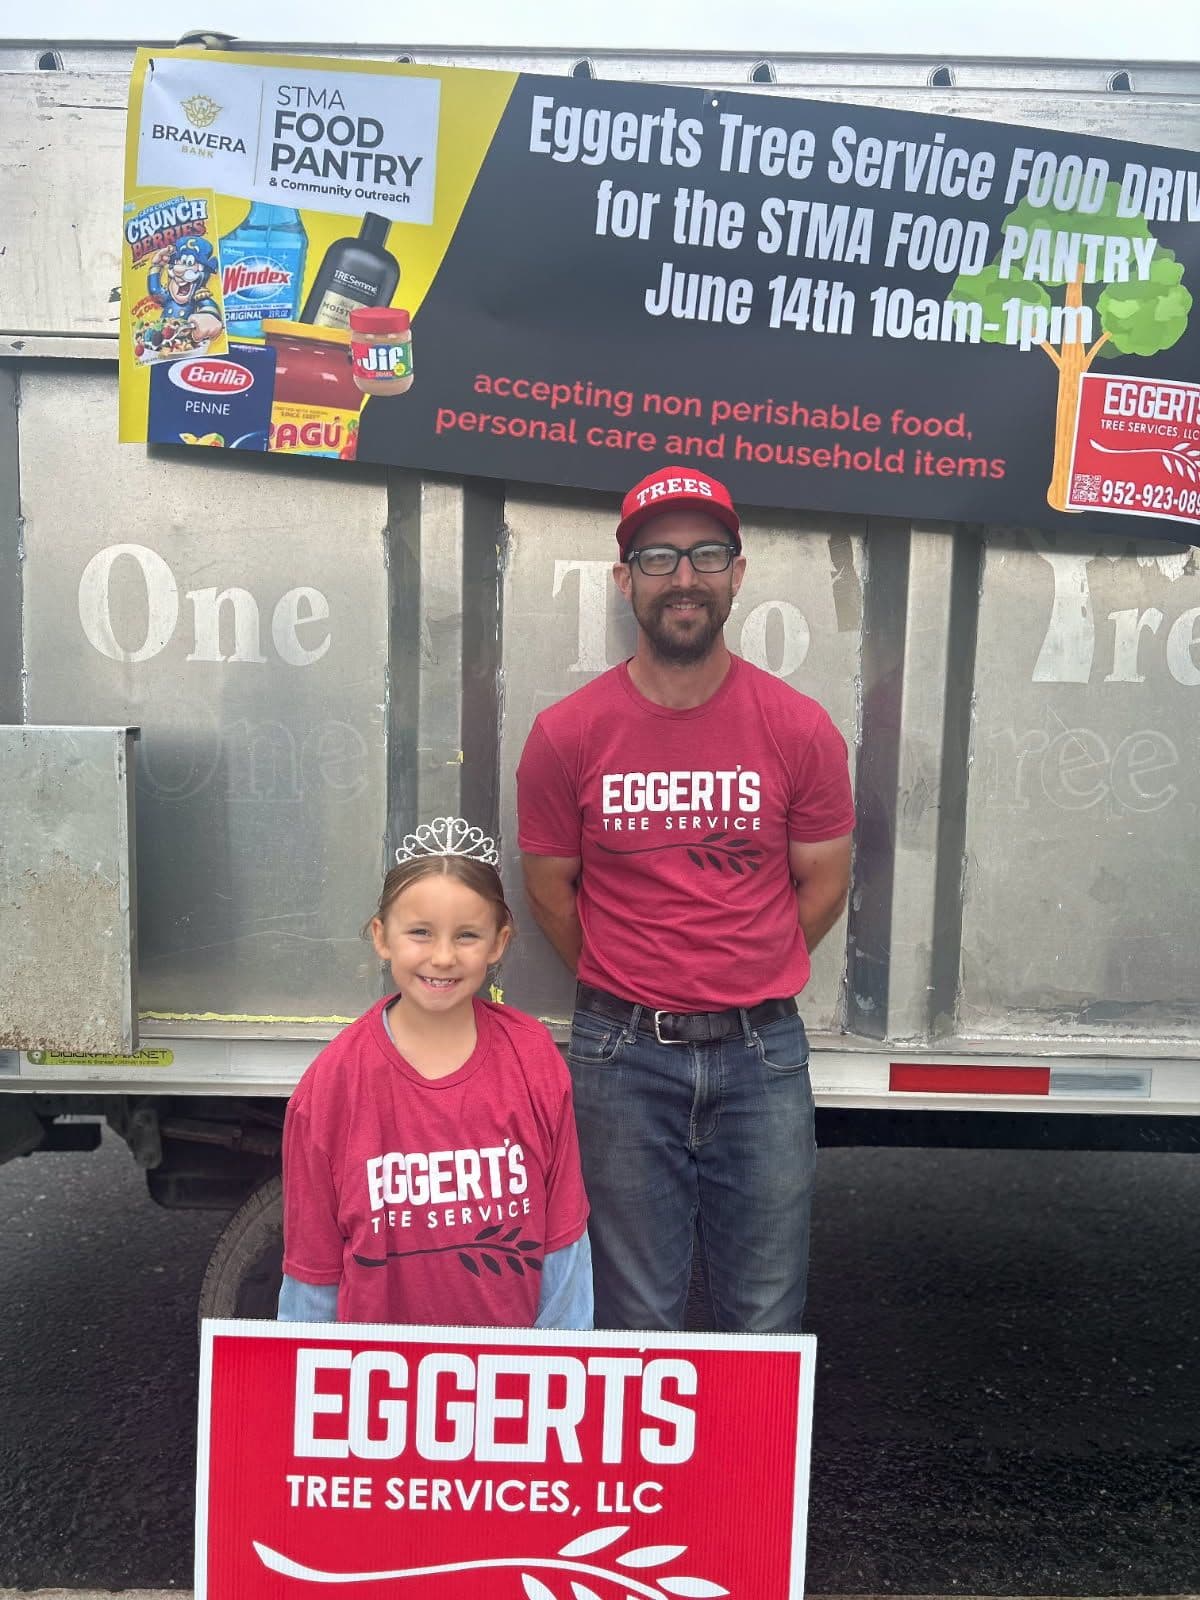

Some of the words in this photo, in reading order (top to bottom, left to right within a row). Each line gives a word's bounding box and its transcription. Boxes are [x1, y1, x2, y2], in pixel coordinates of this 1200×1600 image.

[276, 84, 346, 111] STMA
[152, 124, 247, 154] BRAVERA
[274, 110, 384, 148] FOOD
[181, 145, 215, 159] BANK
[270, 142, 424, 188] PANTRY
[529, 95, 704, 168] Eggerts
[719, 112, 816, 180] Tree
[827, 125, 996, 201] Service
[1004, 147, 1110, 215] FOOD
[269, 177, 279, 187] &
[281, 178, 351, 199] Community
[355, 187, 411, 204] Outreach
[126, 199, 208, 244] CRUNCH
[595, 179, 661, 240] for
[673, 187, 746, 250] the
[757, 197, 875, 264] STMA
[884, 211, 990, 277] FOOD
[998, 225, 1158, 284] PANTRY
[222, 264, 291, 297] Windex
[225, 310, 263, 322] ORIGINAL
[644, 262, 754, 325] June
[768, 275, 856, 335] 14th
[870, 286, 1093, 352] 10am-1pm
[187, 365, 247, 387] Barilla
[362, 346, 404, 371] Jif
[185, 400, 231, 417] PENNE
[473, 373, 633, 417] accepting
[642, 391, 702, 418] non
[710, 399, 882, 435] perishable
[890, 408, 974, 441] food,
[1103, 381, 1200, 426] EGGERT
[435, 405, 577, 446] personal
[586, 424, 657, 453] care
[664, 431, 726, 460] and
[734, 434, 905, 475] household
[914, 448, 1007, 480] items
[1101, 419, 1126, 432] TREE
[1184, 429, 1200, 441] LLC
[636, 477, 713, 507] TREES
[78, 543, 332, 666] One
[552, 559, 811, 679] To
[602, 764, 761, 815] EGGERT'S
[602, 817, 649, 832] TREE
[665, 815, 761, 831] SERVICE
[366, 1138, 528, 1213] EGGERT'S
[371, 1211, 412, 1234] TEE
[427, 1197, 531, 1230] SERVICE
[286, 1474, 373, 1509] TREE
[385, 1477, 582, 1517] SERVICES,
[596, 1480, 664, 1514] LLC
